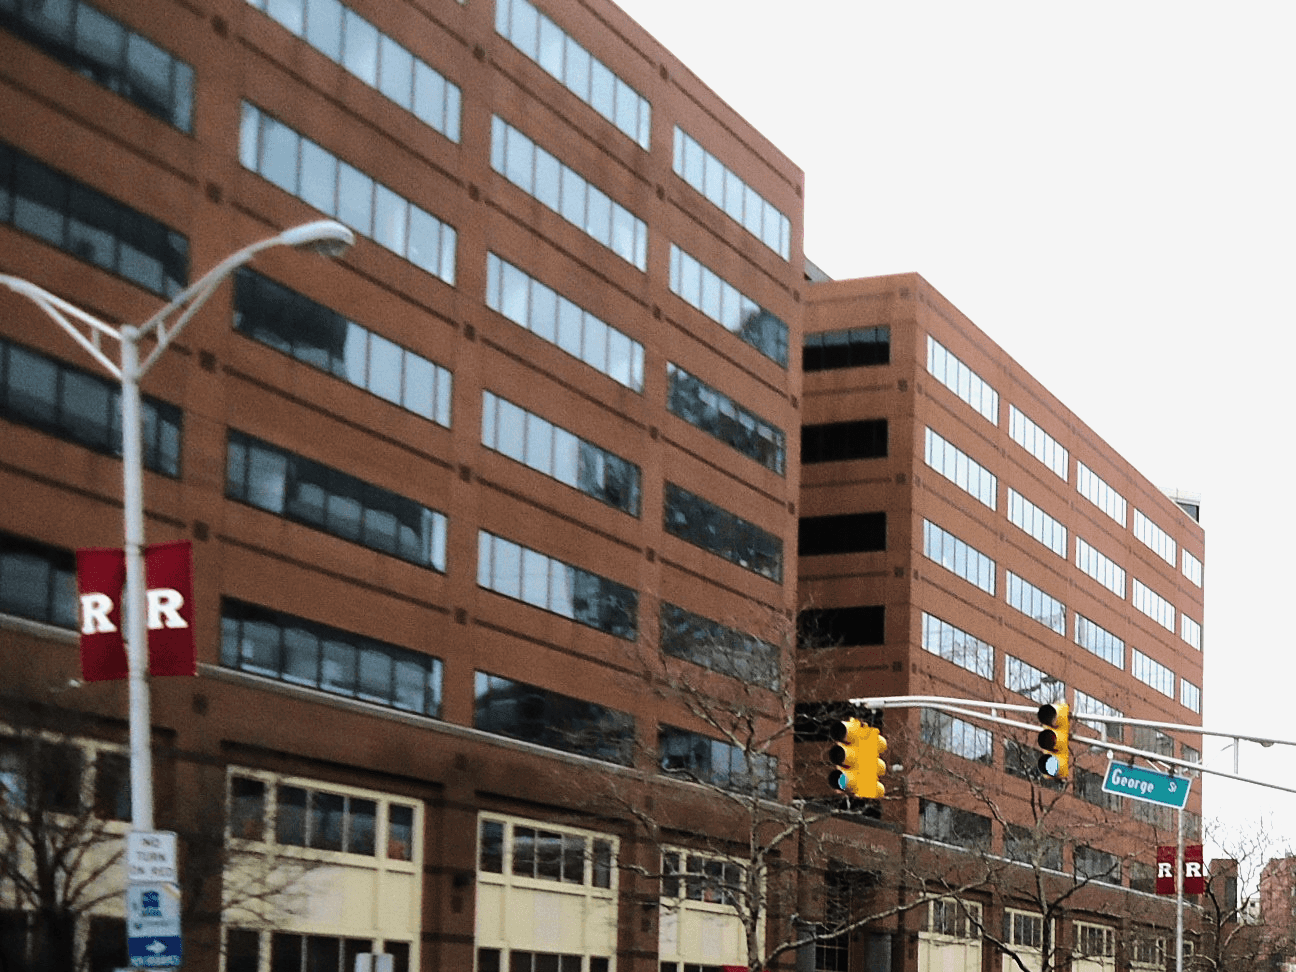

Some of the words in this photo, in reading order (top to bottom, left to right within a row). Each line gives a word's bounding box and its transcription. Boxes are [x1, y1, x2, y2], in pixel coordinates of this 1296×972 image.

[79, 592, 118, 635] R
[146, 588, 189, 630] R
[1111, 768, 1155, 795] George
[1158, 862, 1173, 878] R
[1185, 862, 1202, 878] R
